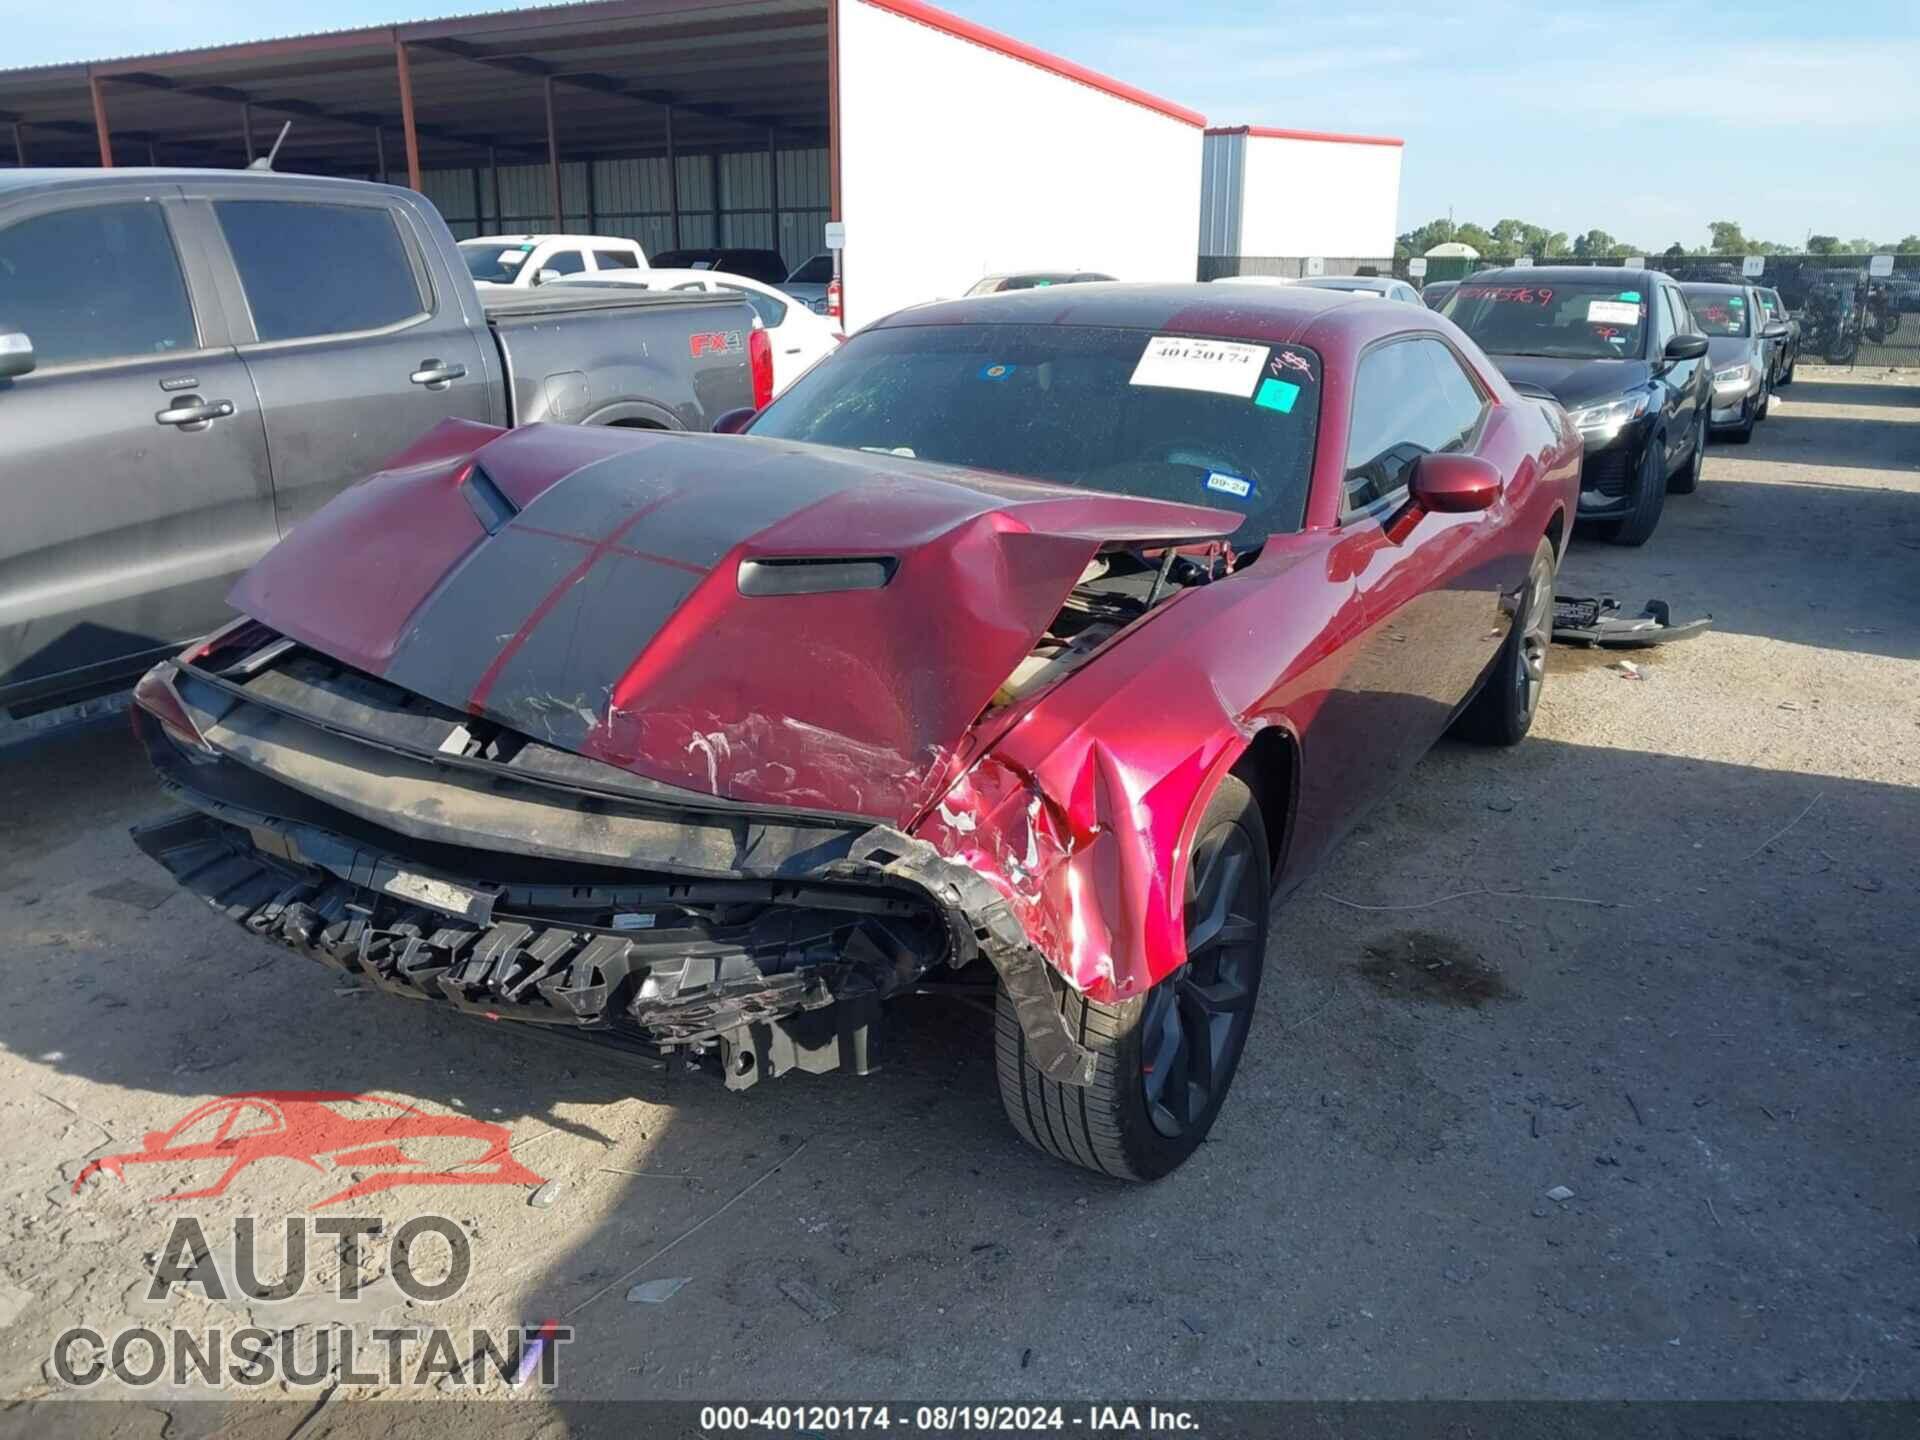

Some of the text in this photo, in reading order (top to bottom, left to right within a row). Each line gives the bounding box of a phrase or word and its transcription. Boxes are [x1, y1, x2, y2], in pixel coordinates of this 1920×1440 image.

[688, 331, 743, 358] FX4
[1156, 347, 1250, 364] 40120174
[1210, 476, 1247, 493] 09-24
